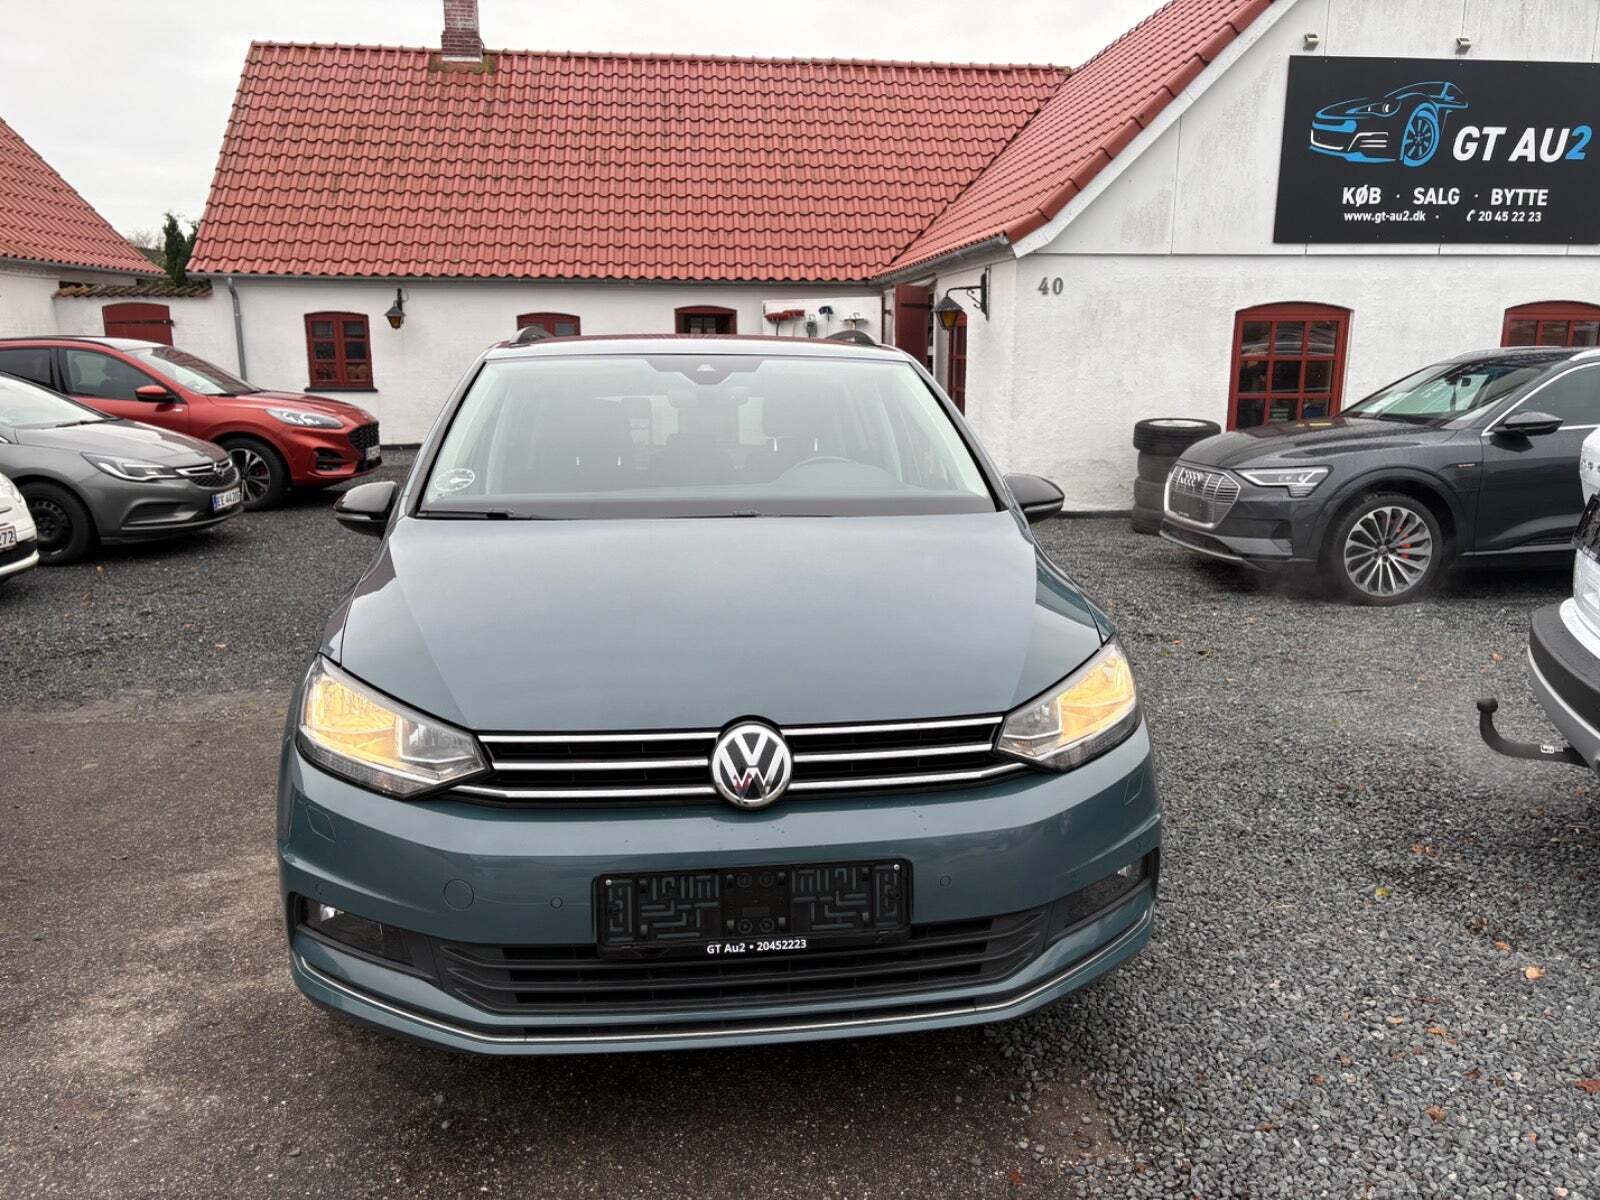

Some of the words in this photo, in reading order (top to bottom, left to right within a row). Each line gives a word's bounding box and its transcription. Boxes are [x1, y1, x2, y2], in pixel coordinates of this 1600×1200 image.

[1453, 126, 1507, 161] GT
[1508, 125, 1592, 163] AU2
[1342, 184, 1382, 207] KØB
[1413, 187, 1460, 205] SALG
[1491, 188, 1549, 206] BYTTE
[1344, 210, 1426, 224] www.gt-au2.dk
[1478, 211, 1493, 222] 20
[1494, 211, 1509, 222] 45
[1511, 211, 1526, 222] 22
[1527, 211, 1542, 223] 23
[1038, 276, 1064, 295] 40
[0, 531, 14, 546] 72
[706, 944, 721, 954] GT
[724, 942, 746, 953] Au2
[756, 939, 807, 951] 20452223
